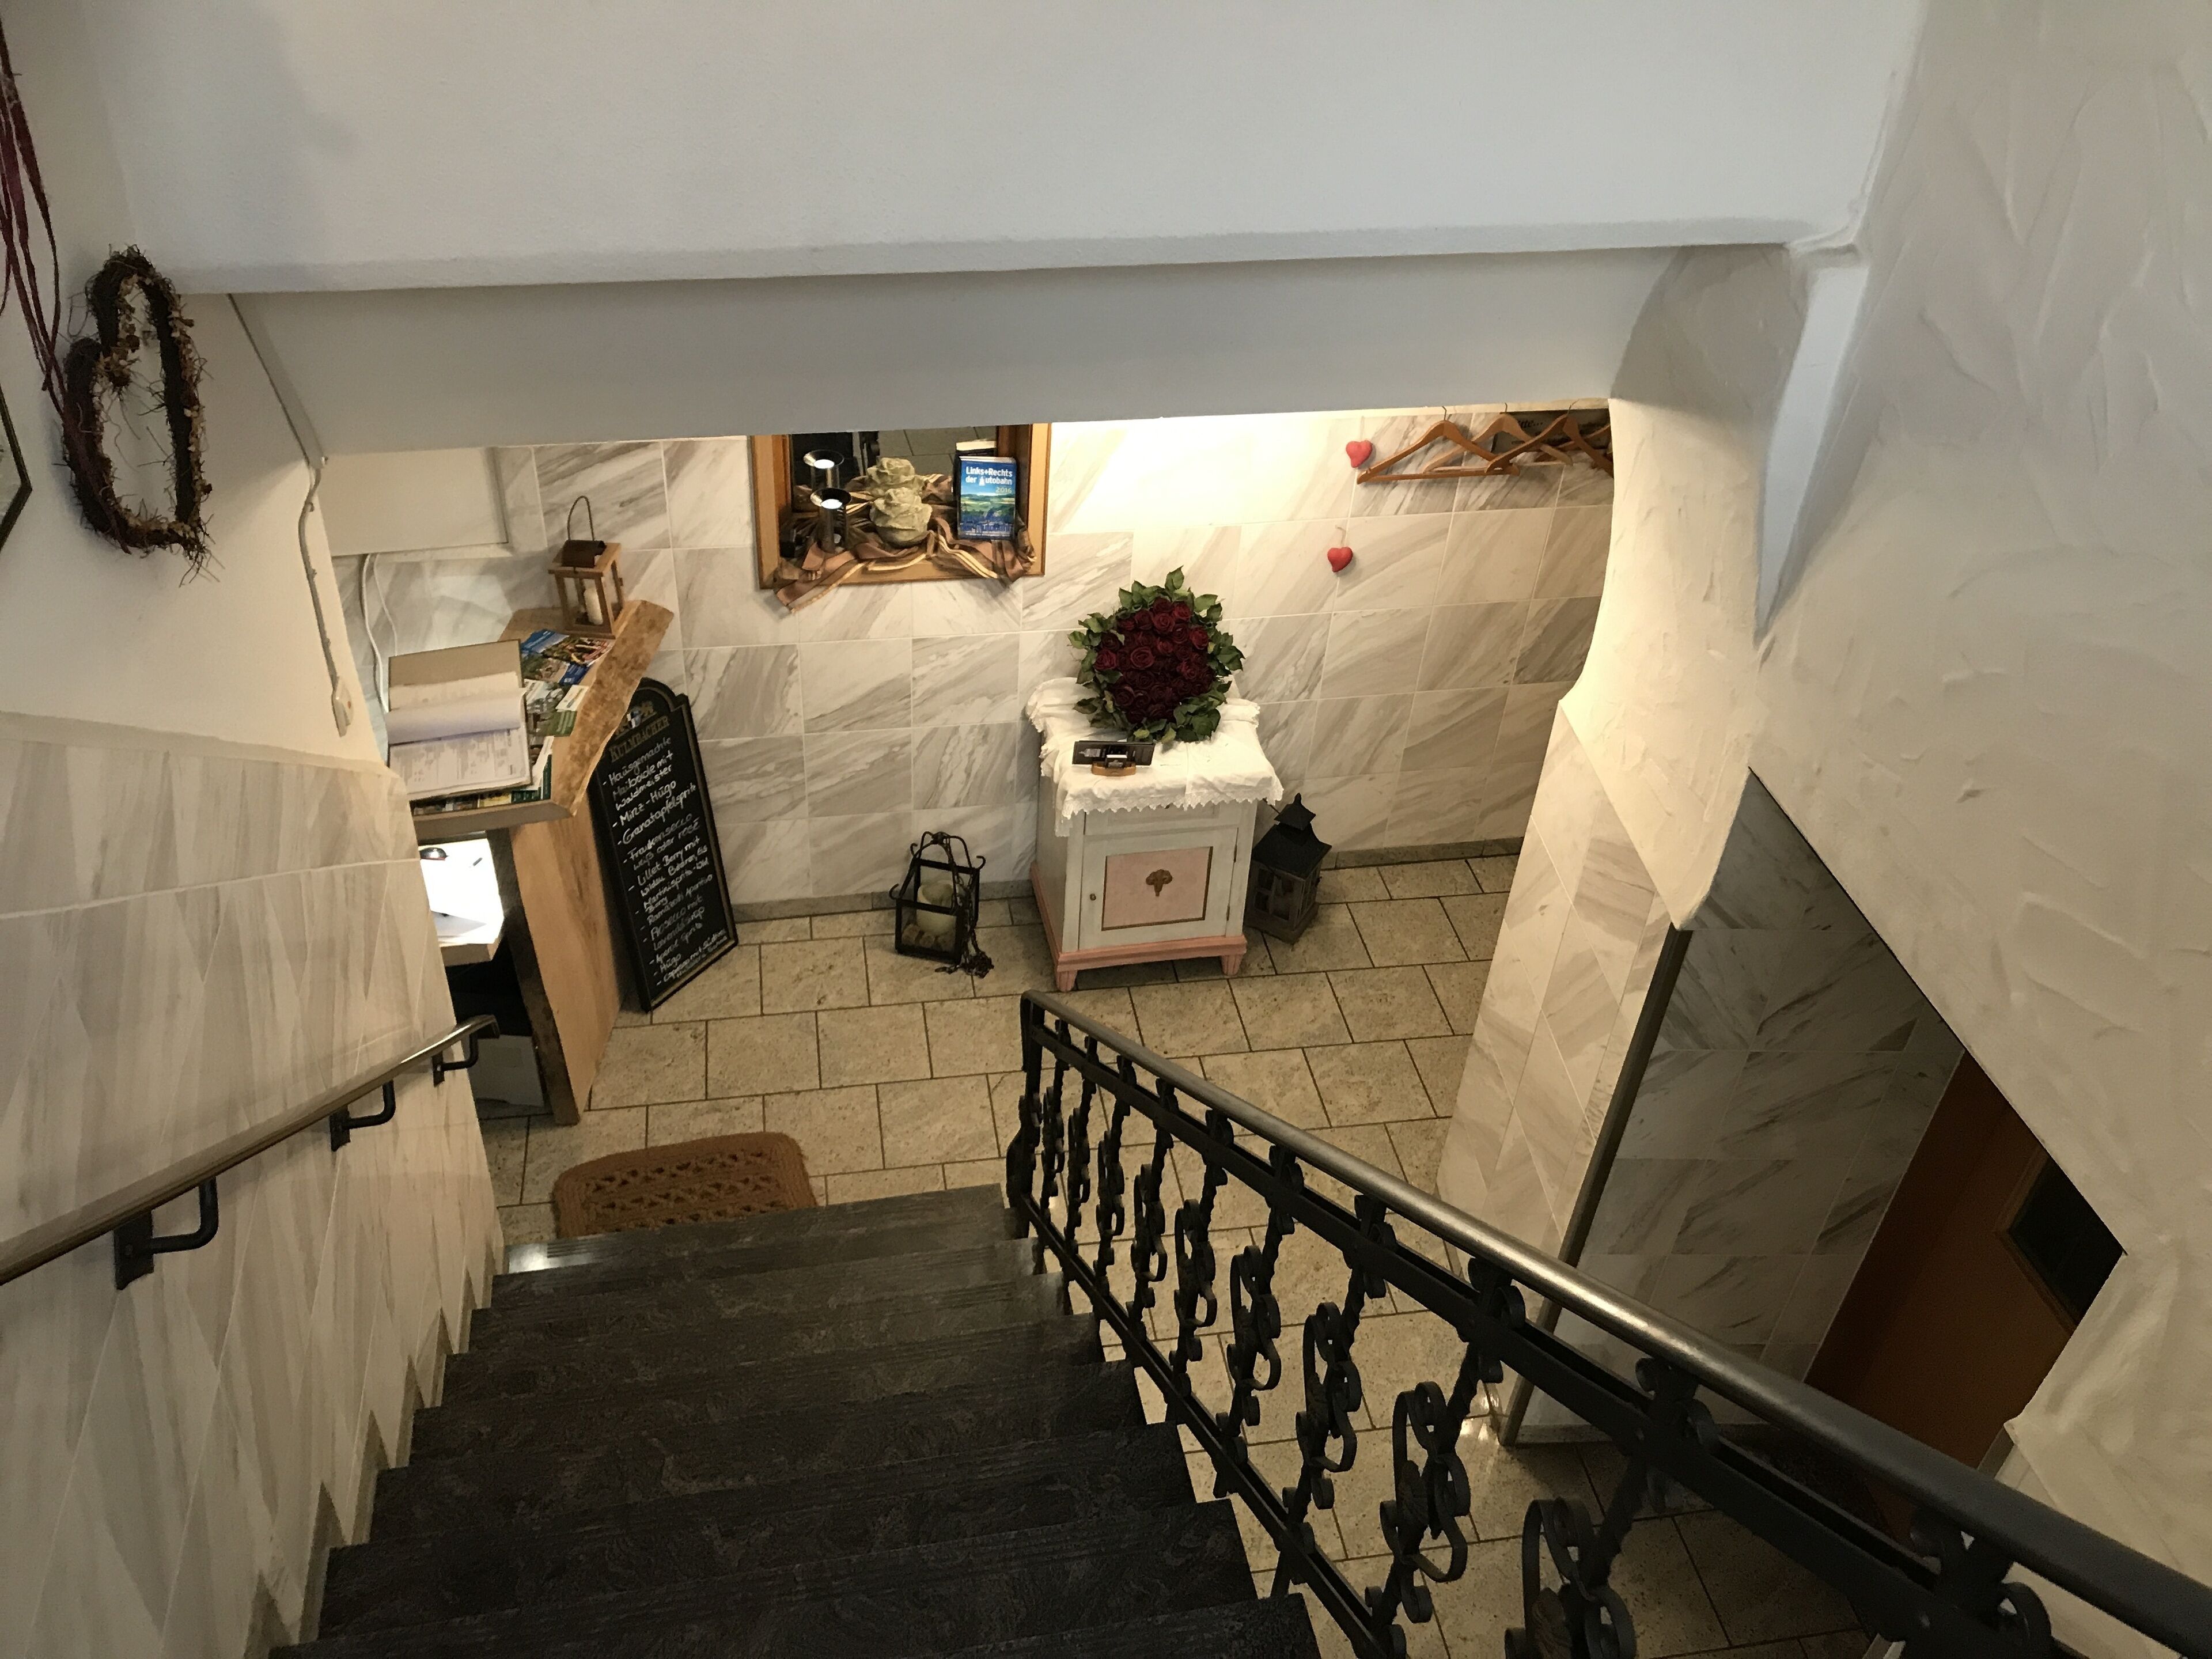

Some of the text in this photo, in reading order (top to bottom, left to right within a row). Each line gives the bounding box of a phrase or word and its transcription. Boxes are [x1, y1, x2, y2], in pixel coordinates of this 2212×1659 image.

[965, 466, 1013, 478] Links+Rechts
[608, 715, 670, 763] KULMBACHER
[657, 750, 673, 768] mit
[657, 836, 675, 853] oder
[684, 836, 700, 851] mit
